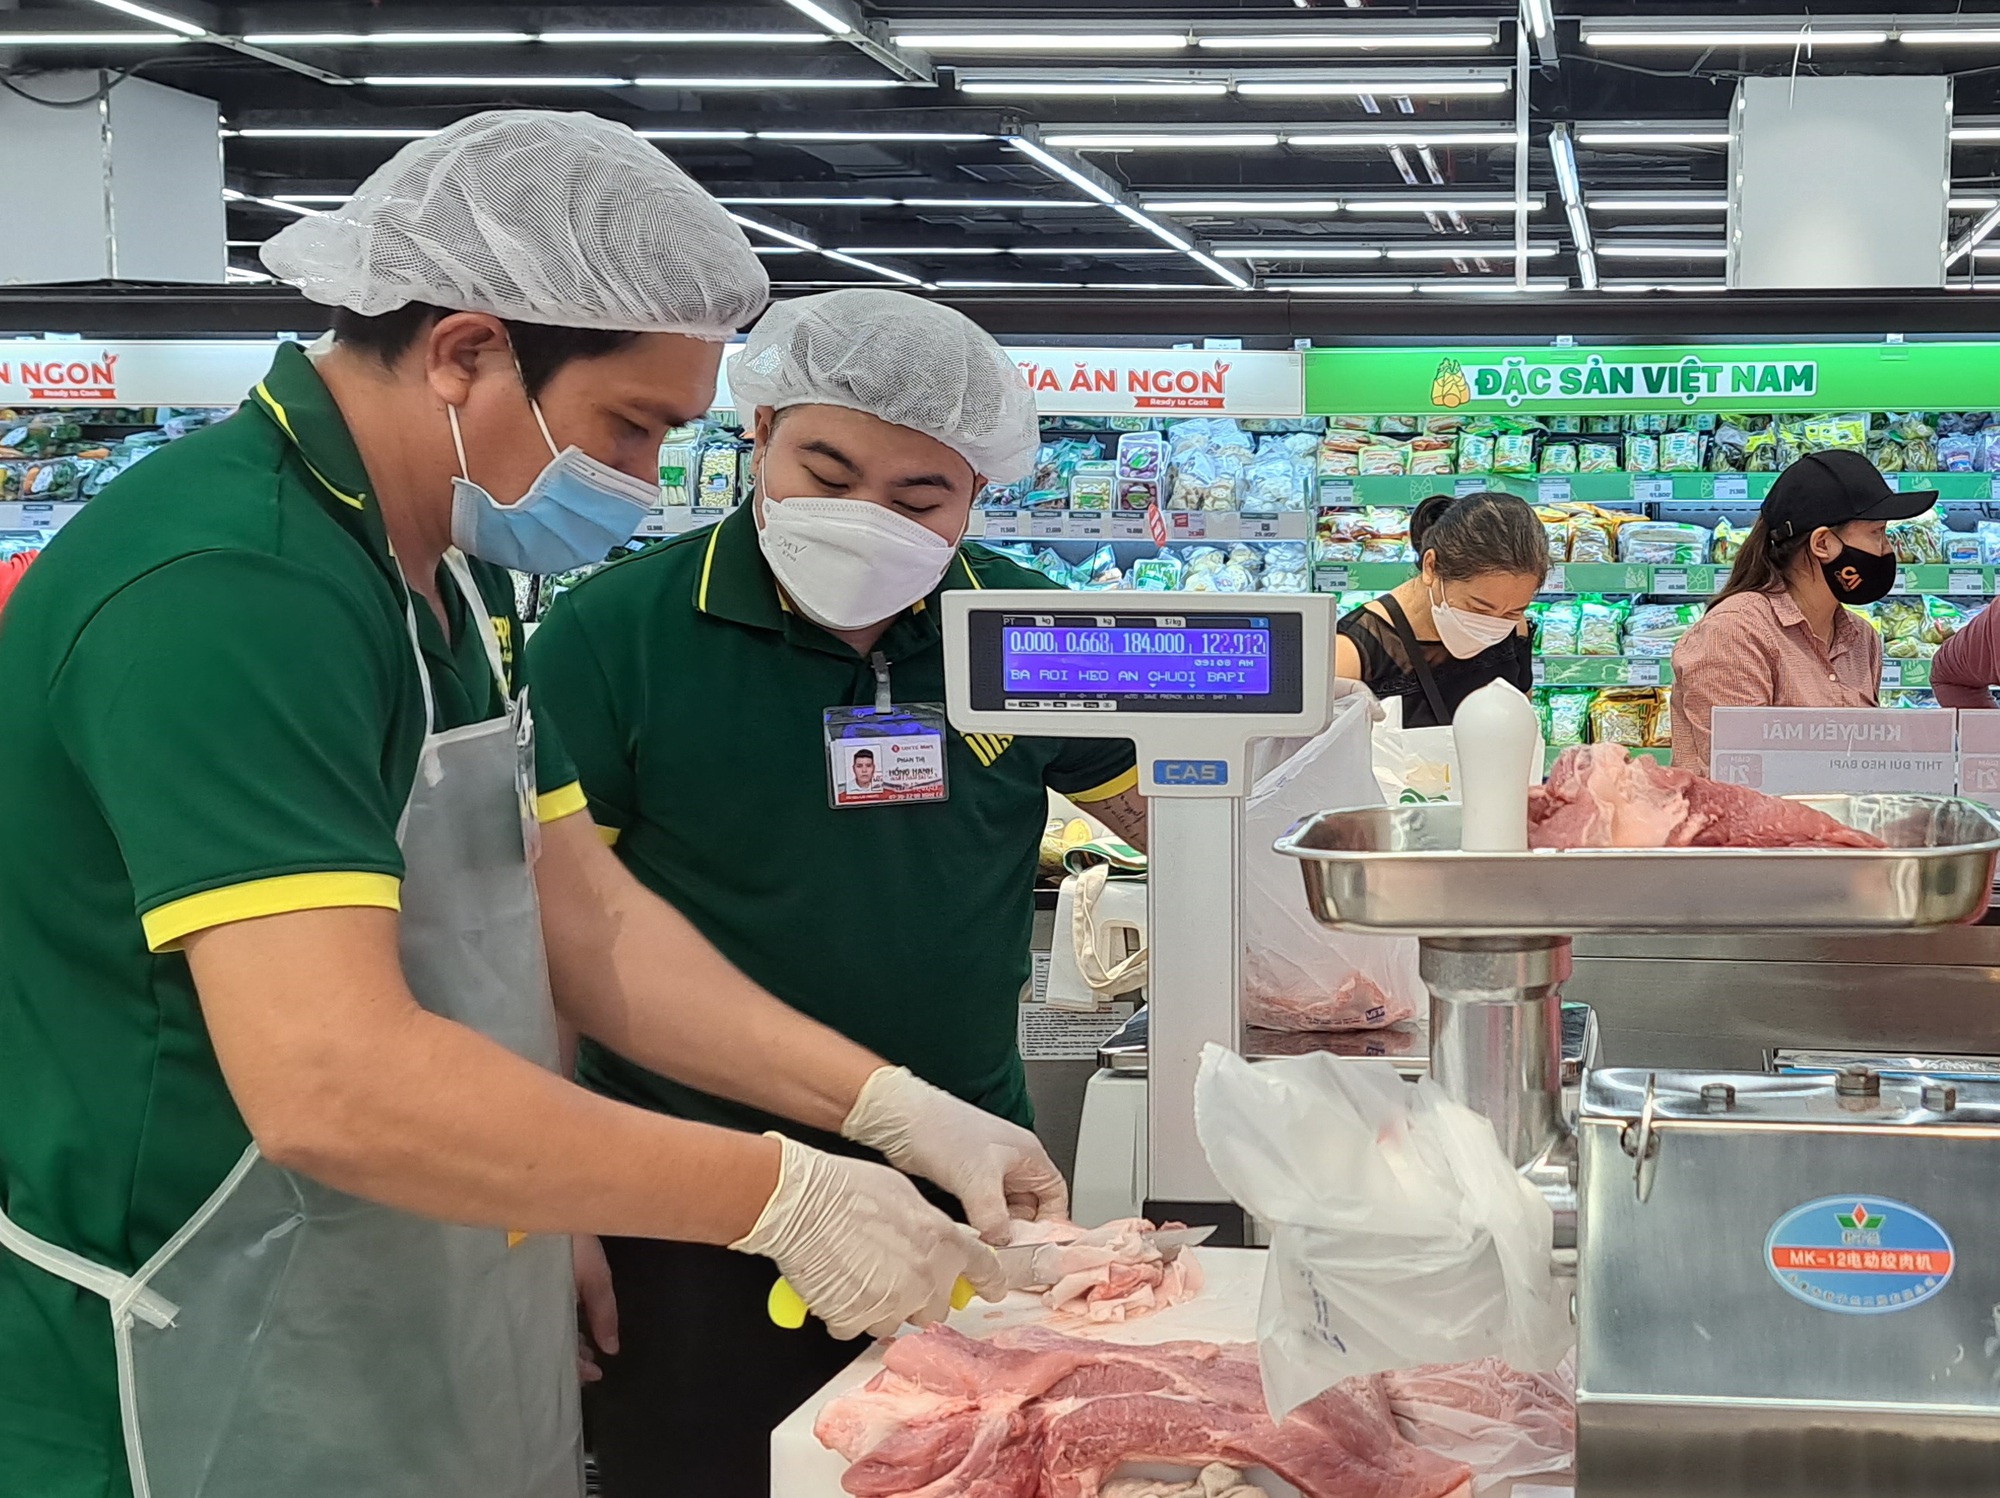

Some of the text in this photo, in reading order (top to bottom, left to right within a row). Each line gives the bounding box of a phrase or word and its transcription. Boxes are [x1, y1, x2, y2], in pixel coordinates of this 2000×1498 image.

[21, 362, 114, 384] NGON
[1069, 363, 1117, 392] ĂN
[1128, 369, 1225, 394] NGON
[1475, 358, 1813, 402] ĐẶC SẢN VIỆT NAM
[1150, 398, 1176, 407] Ready
[1003, 617, 1015, 625] PT
[1042, 616, 1052, 625] kg
[1103, 617, 1112, 625] kg
[1238, 659, 1254, 667] AM
[1010, 669, 1246, 683] BA ROI HEO AN CHUOI BAPI
[1165, 764, 1217, 780] CAS
